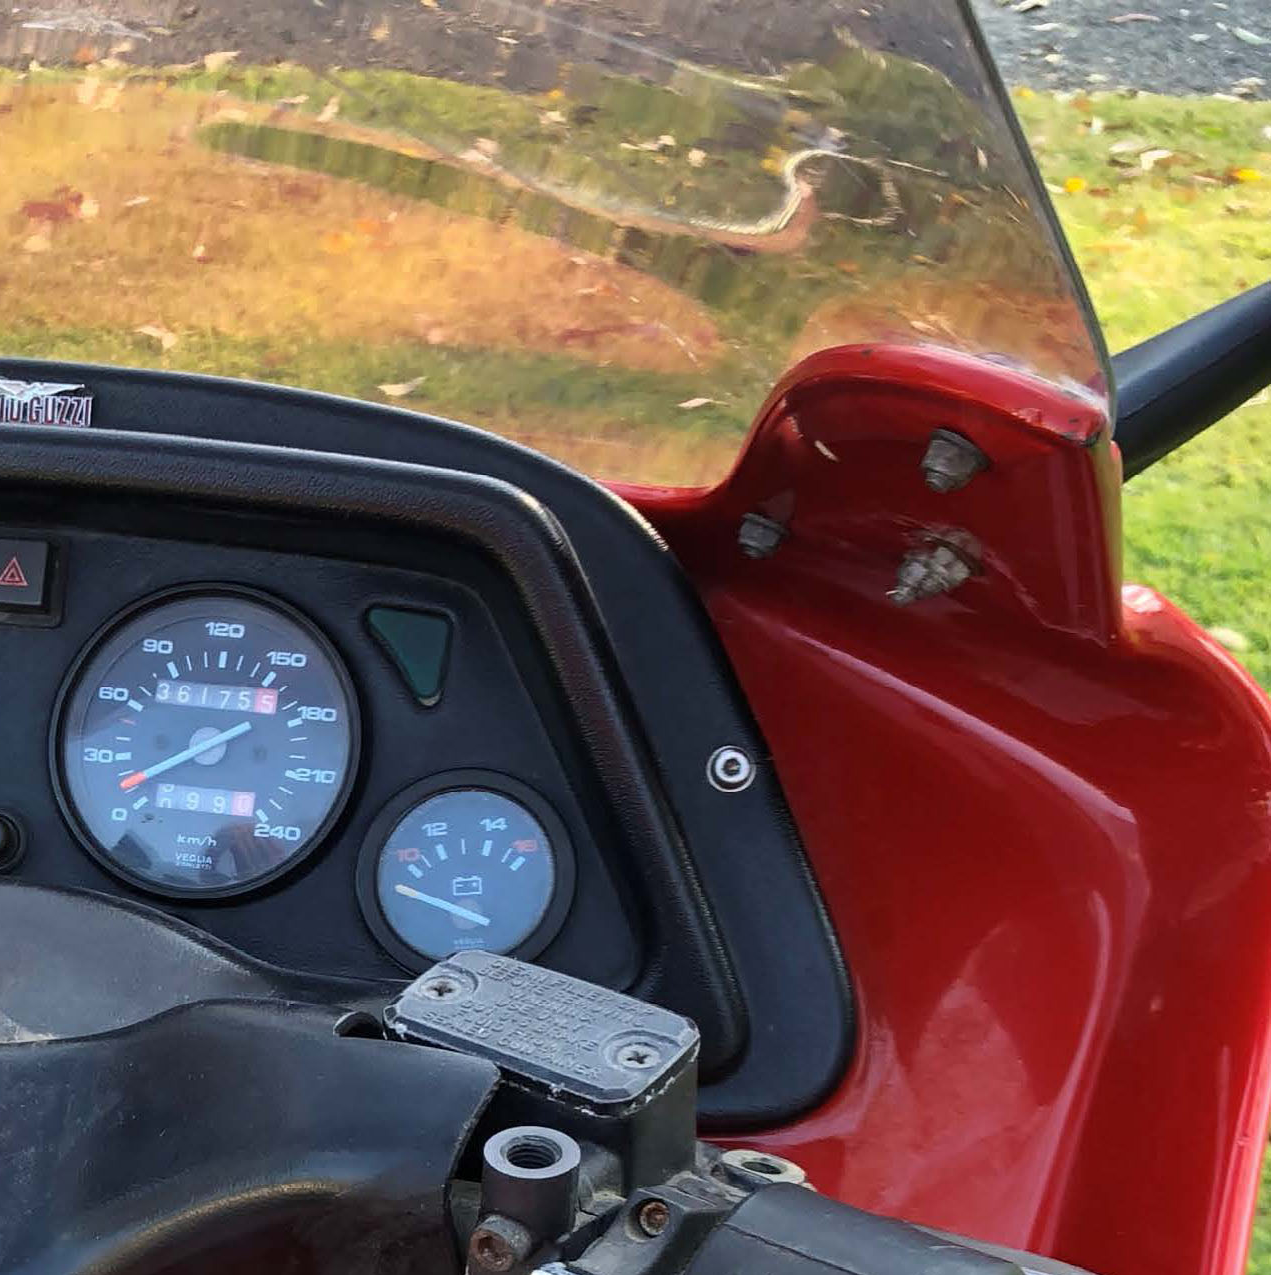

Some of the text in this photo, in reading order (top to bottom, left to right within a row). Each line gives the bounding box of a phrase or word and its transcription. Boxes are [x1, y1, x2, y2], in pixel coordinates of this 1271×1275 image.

[27, 395, 93, 427] GUZZI
[204, 622, 245, 637] 120
[142, 638, 173, 654] 90
[266, 650, 307, 668] 150
[99, 687, 128, 701] 60
[297, 706, 337, 722] 180
[83, 749, 113, 763] 30
[296, 768, 336, 784] 210
[111, 808, 127, 821] 0
[253, 823, 301, 840] 240
[421, 822, 448, 837] 12
[480, 817, 508, 832] 14
[176, 833, 218, 848] km/h
[174, 851, 213, 865] VEGLIA
